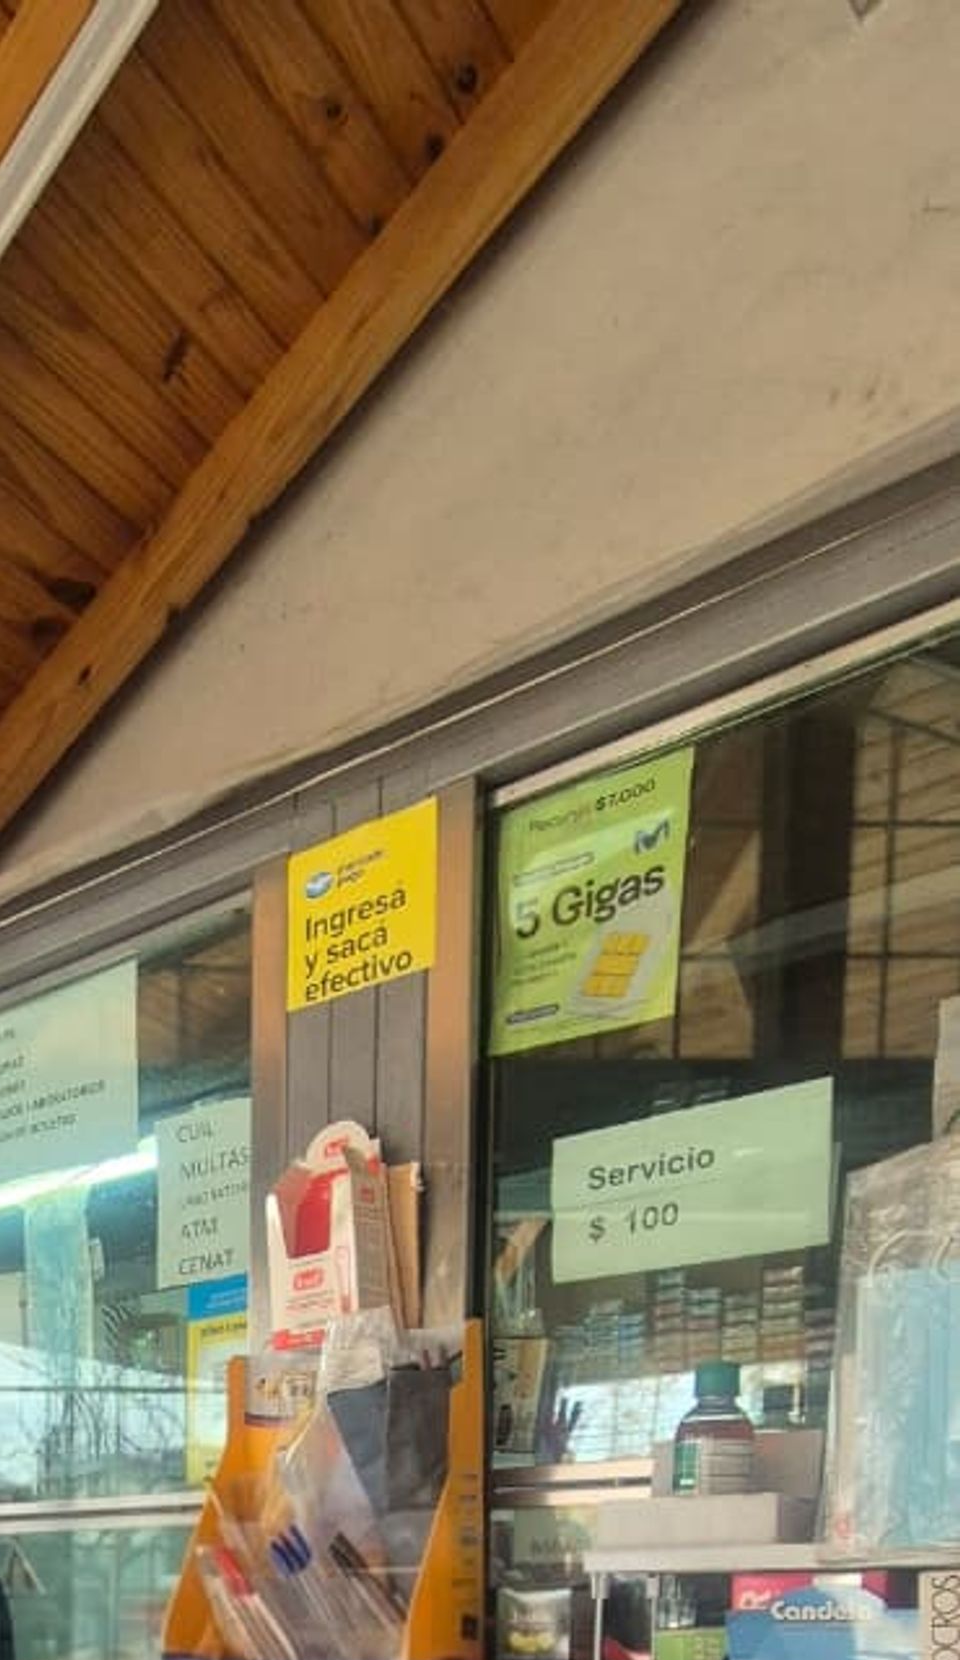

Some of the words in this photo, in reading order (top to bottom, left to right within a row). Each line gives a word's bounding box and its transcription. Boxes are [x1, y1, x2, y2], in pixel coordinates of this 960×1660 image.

[515, 896, 541, 939] 5
[552, 865, 665, 925] Gigas
[305, 953, 319, 979] y
[305, 950, 413, 1002] efectivo
[587, 1146, 716, 1190] Servicio
[588, 1214, 607, 1243] $
[626, 1202, 680, 1235] 100
[179, 1249, 234, 1275] CENAT
[770, 1599, 872, 1621] Candela
